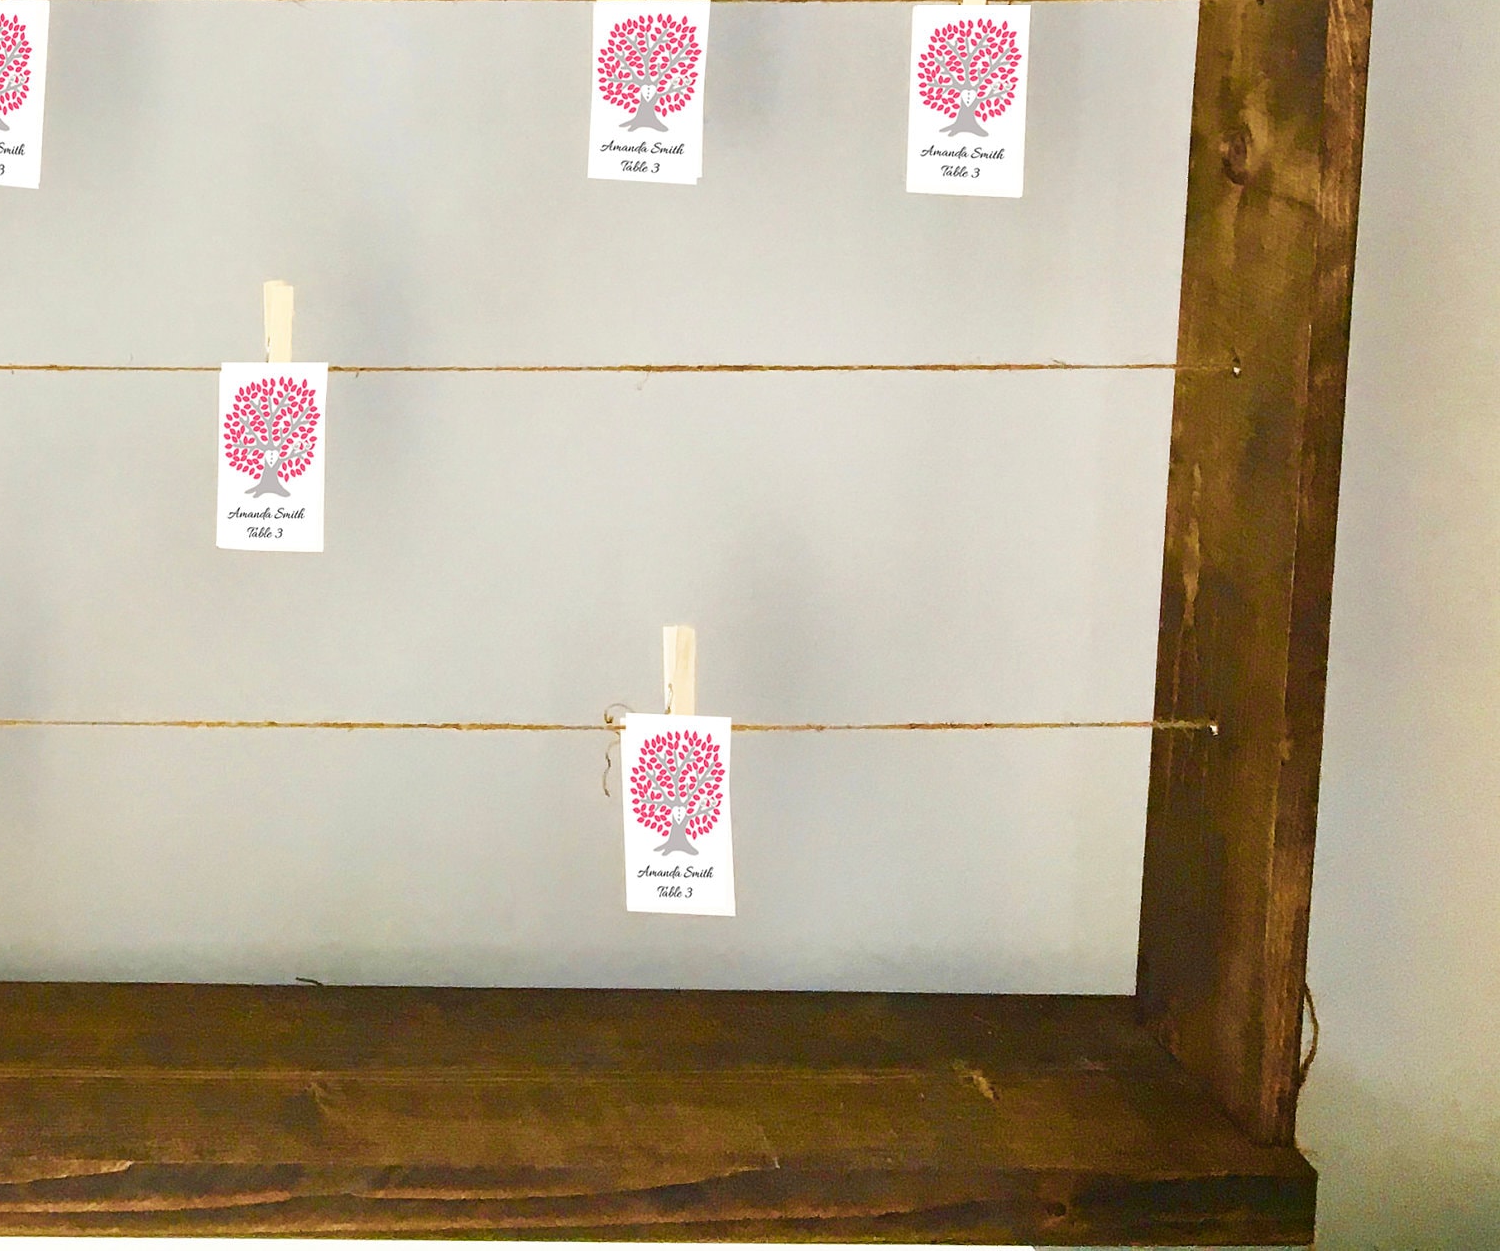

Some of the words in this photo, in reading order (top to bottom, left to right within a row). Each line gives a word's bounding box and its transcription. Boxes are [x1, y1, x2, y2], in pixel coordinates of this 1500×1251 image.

[599, 139, 649, 155] Amanda
[650, 141, 685, 155] Smith
[920, 144, 968, 160] Amanda
[970, 146, 1005, 160] Smith
[620, 159, 648, 173] Table
[650, 162, 661, 174] 3
[940, 164, 969, 178] Table
[970, 167, 981, 179] 3
[227, 506, 272, 521] Amanda
[273, 507, 306, 520] Smith
[246, 526, 273, 539] Table
[274, 527, 284, 539] 3
[637, 864, 681, 880] Amanda
[683, 865, 714, 879] Smith
[656, 885, 683, 898] Table
[684, 886, 693, 899] 3
